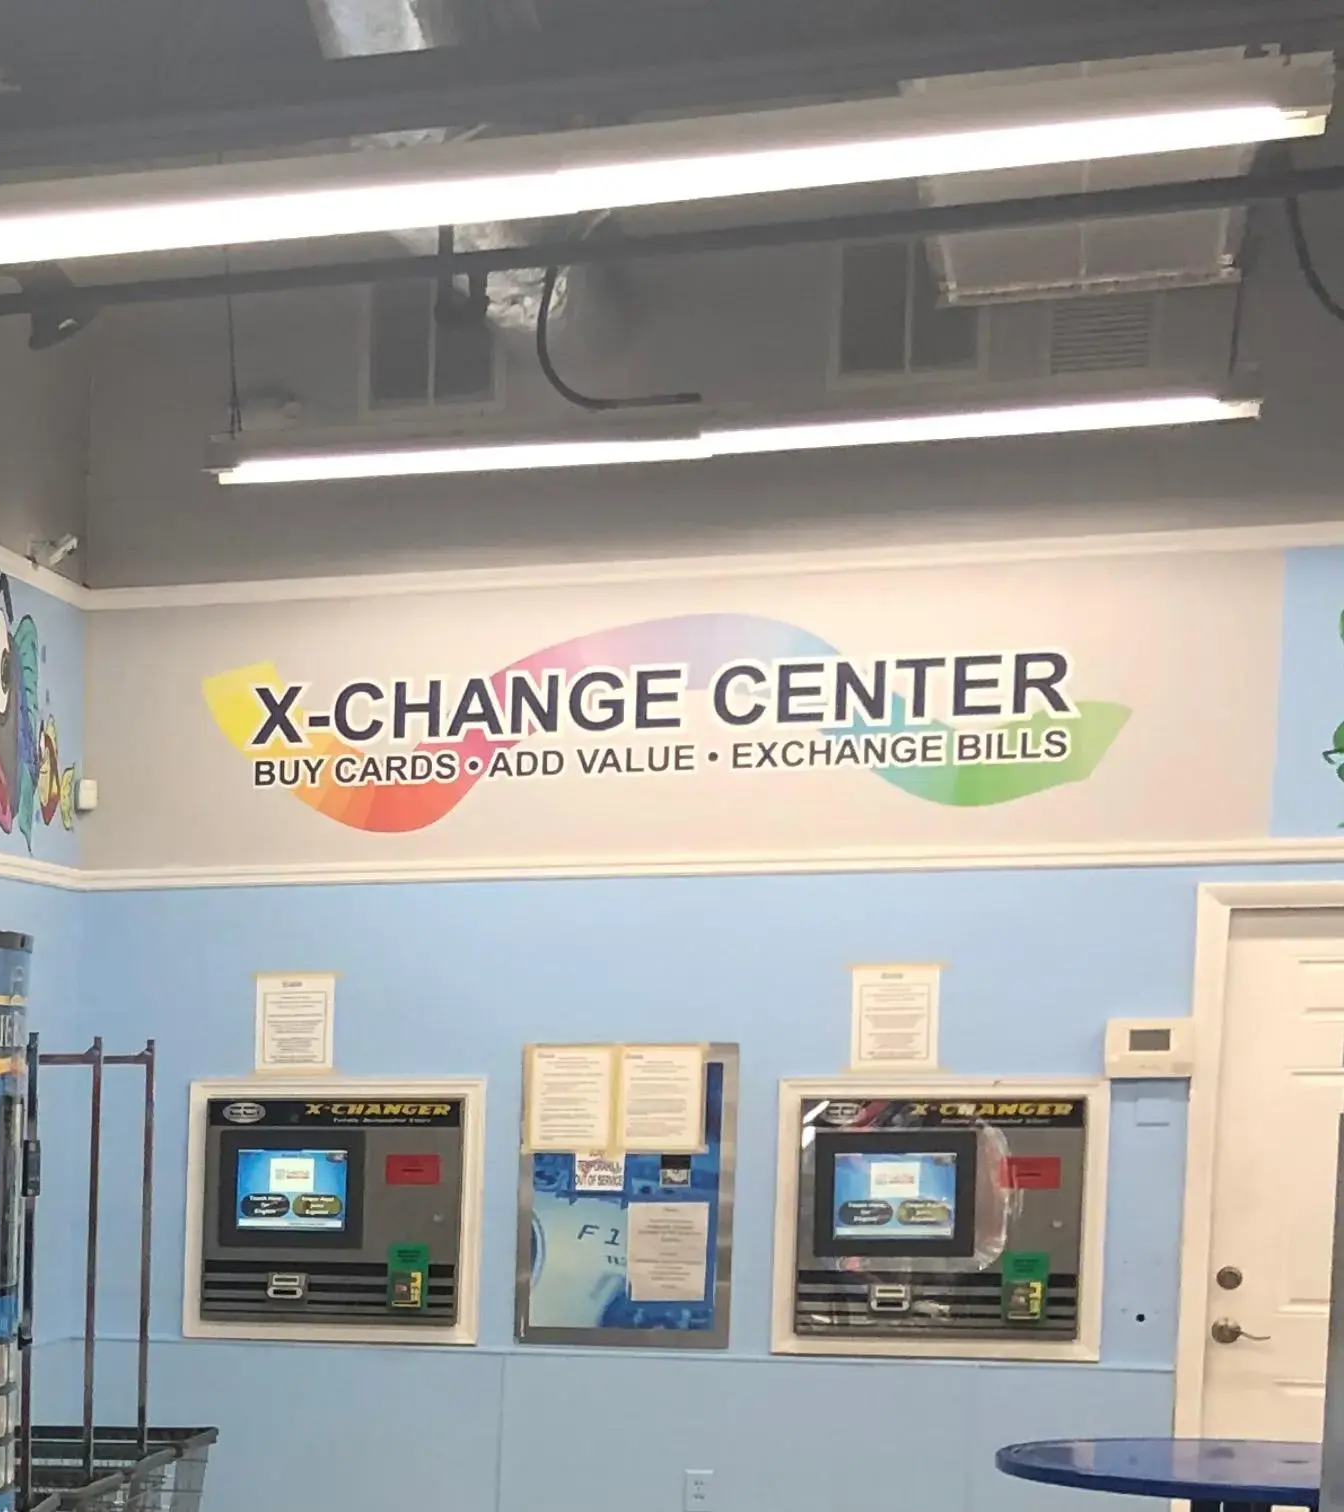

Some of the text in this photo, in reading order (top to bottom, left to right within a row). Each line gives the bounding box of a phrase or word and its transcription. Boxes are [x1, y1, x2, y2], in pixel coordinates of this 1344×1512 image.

[253, 652, 1071, 745] X-CHANGE CENTER
[254, 729, 1069, 787] BUY CARDS ADD VALUE EXCHANGE BILLS
[304, 1103, 452, 1116] X-CHANGER
[911, 1102, 1073, 1117] X-CHANGER
